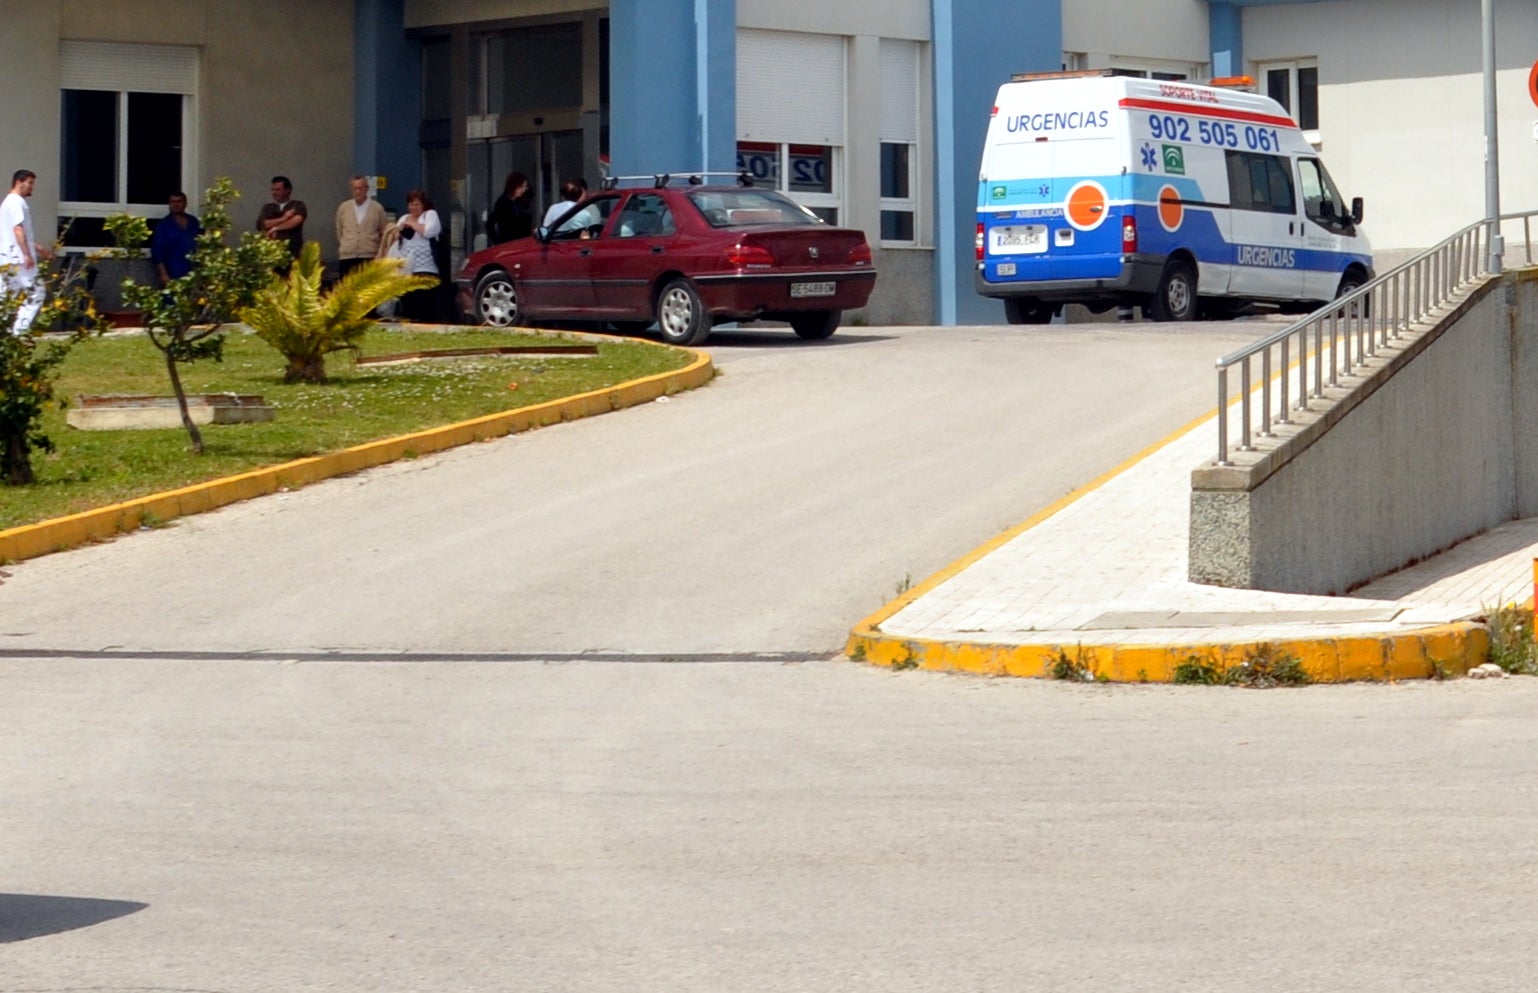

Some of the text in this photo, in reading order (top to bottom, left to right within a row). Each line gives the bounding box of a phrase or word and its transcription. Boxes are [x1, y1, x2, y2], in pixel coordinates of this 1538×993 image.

[1007, 110, 1109, 133] URGENCIAS
[1149, 114, 1280, 152] 902 505 061
[1237, 245, 1296, 268] URGENCIAS
